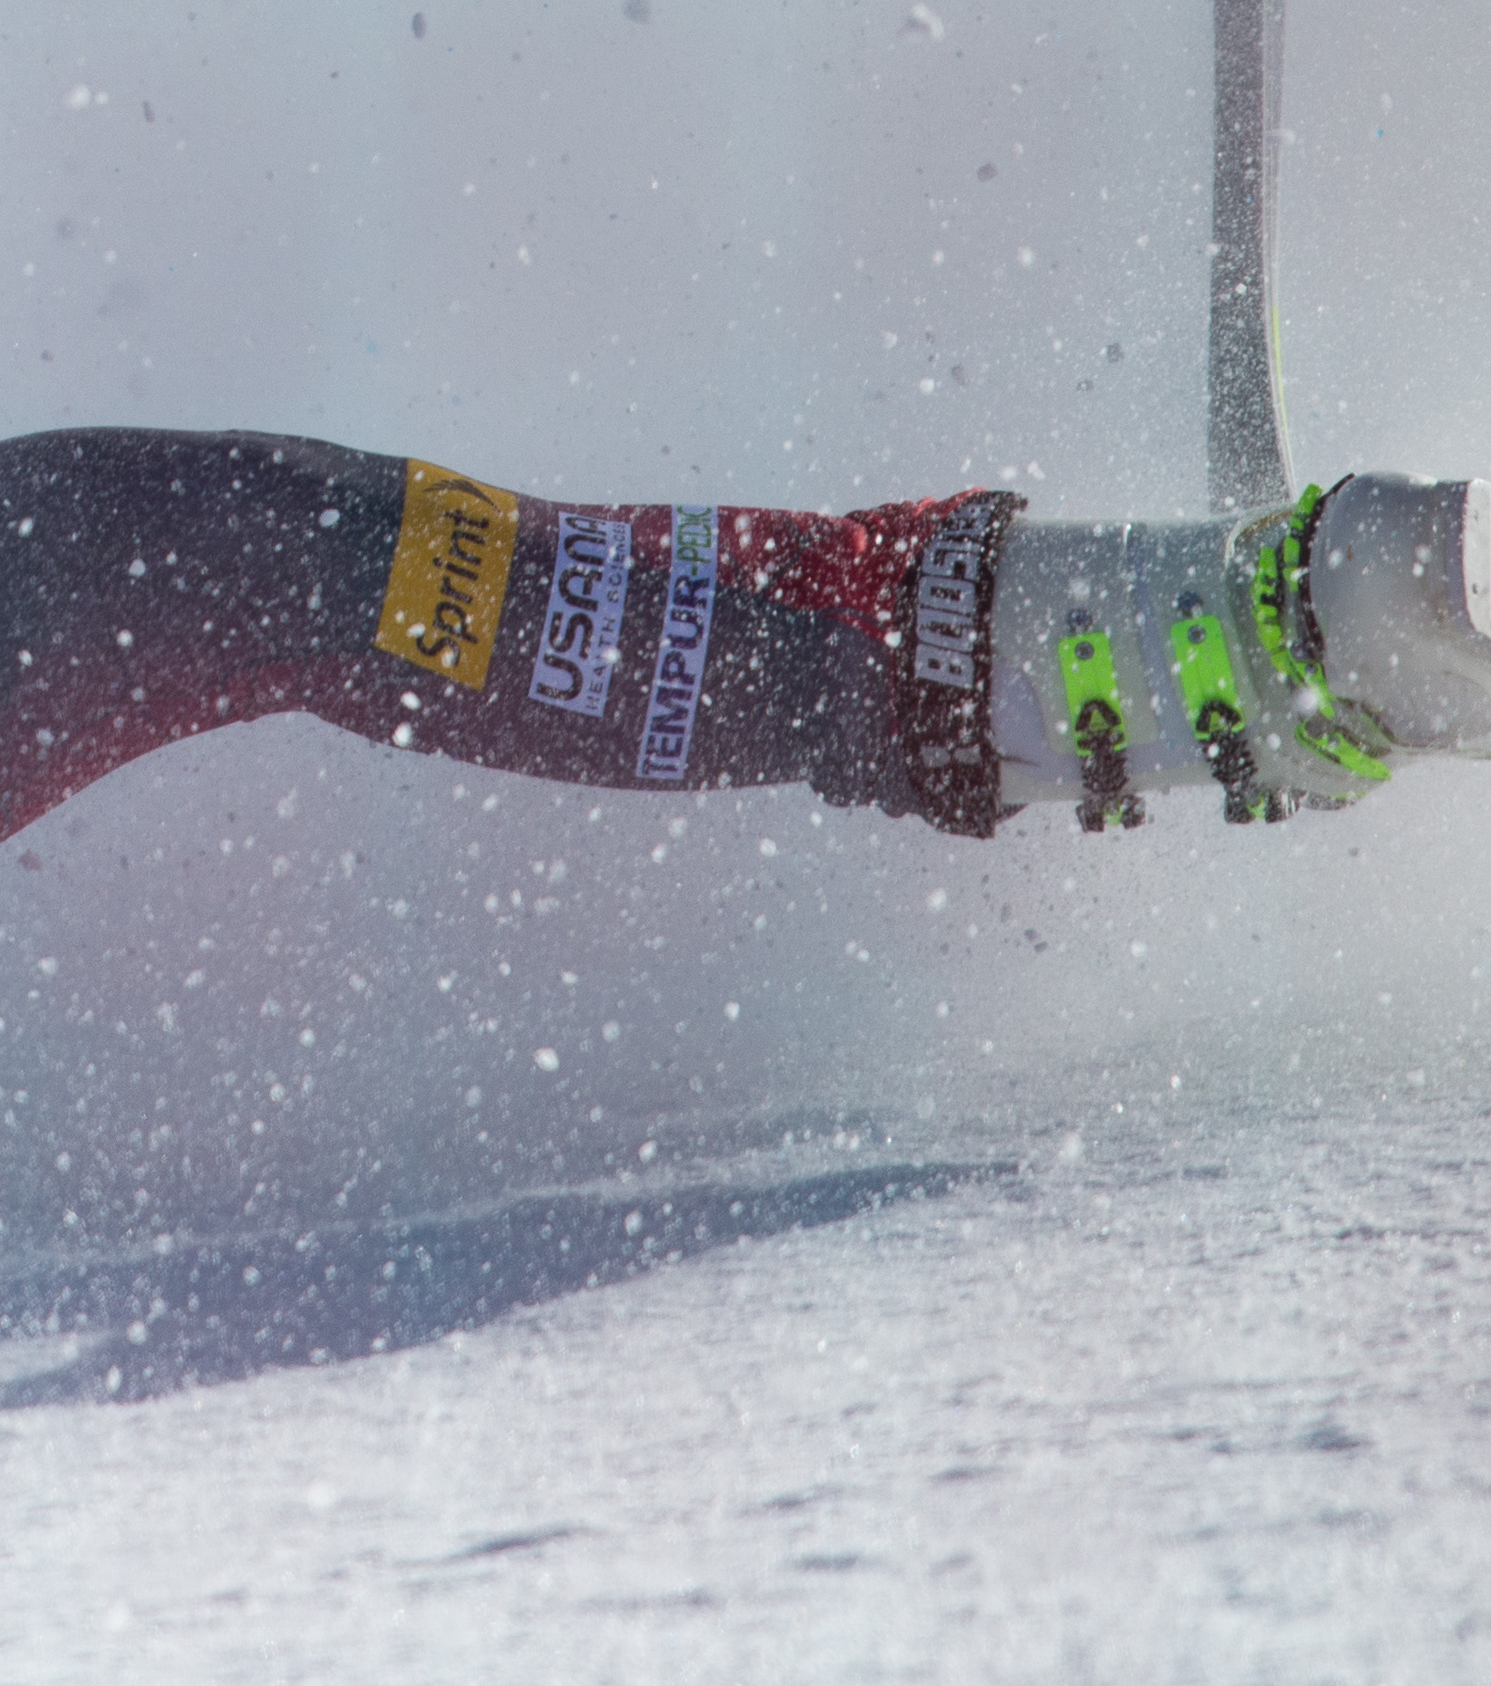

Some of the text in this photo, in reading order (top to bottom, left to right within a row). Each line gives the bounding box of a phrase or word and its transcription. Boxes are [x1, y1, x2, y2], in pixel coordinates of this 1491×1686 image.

[416, 509, 490, 667] Sprint
[535, 515, 608, 702] USANA
[643, 505, 714, 775] TEMPUR-PEDIC
